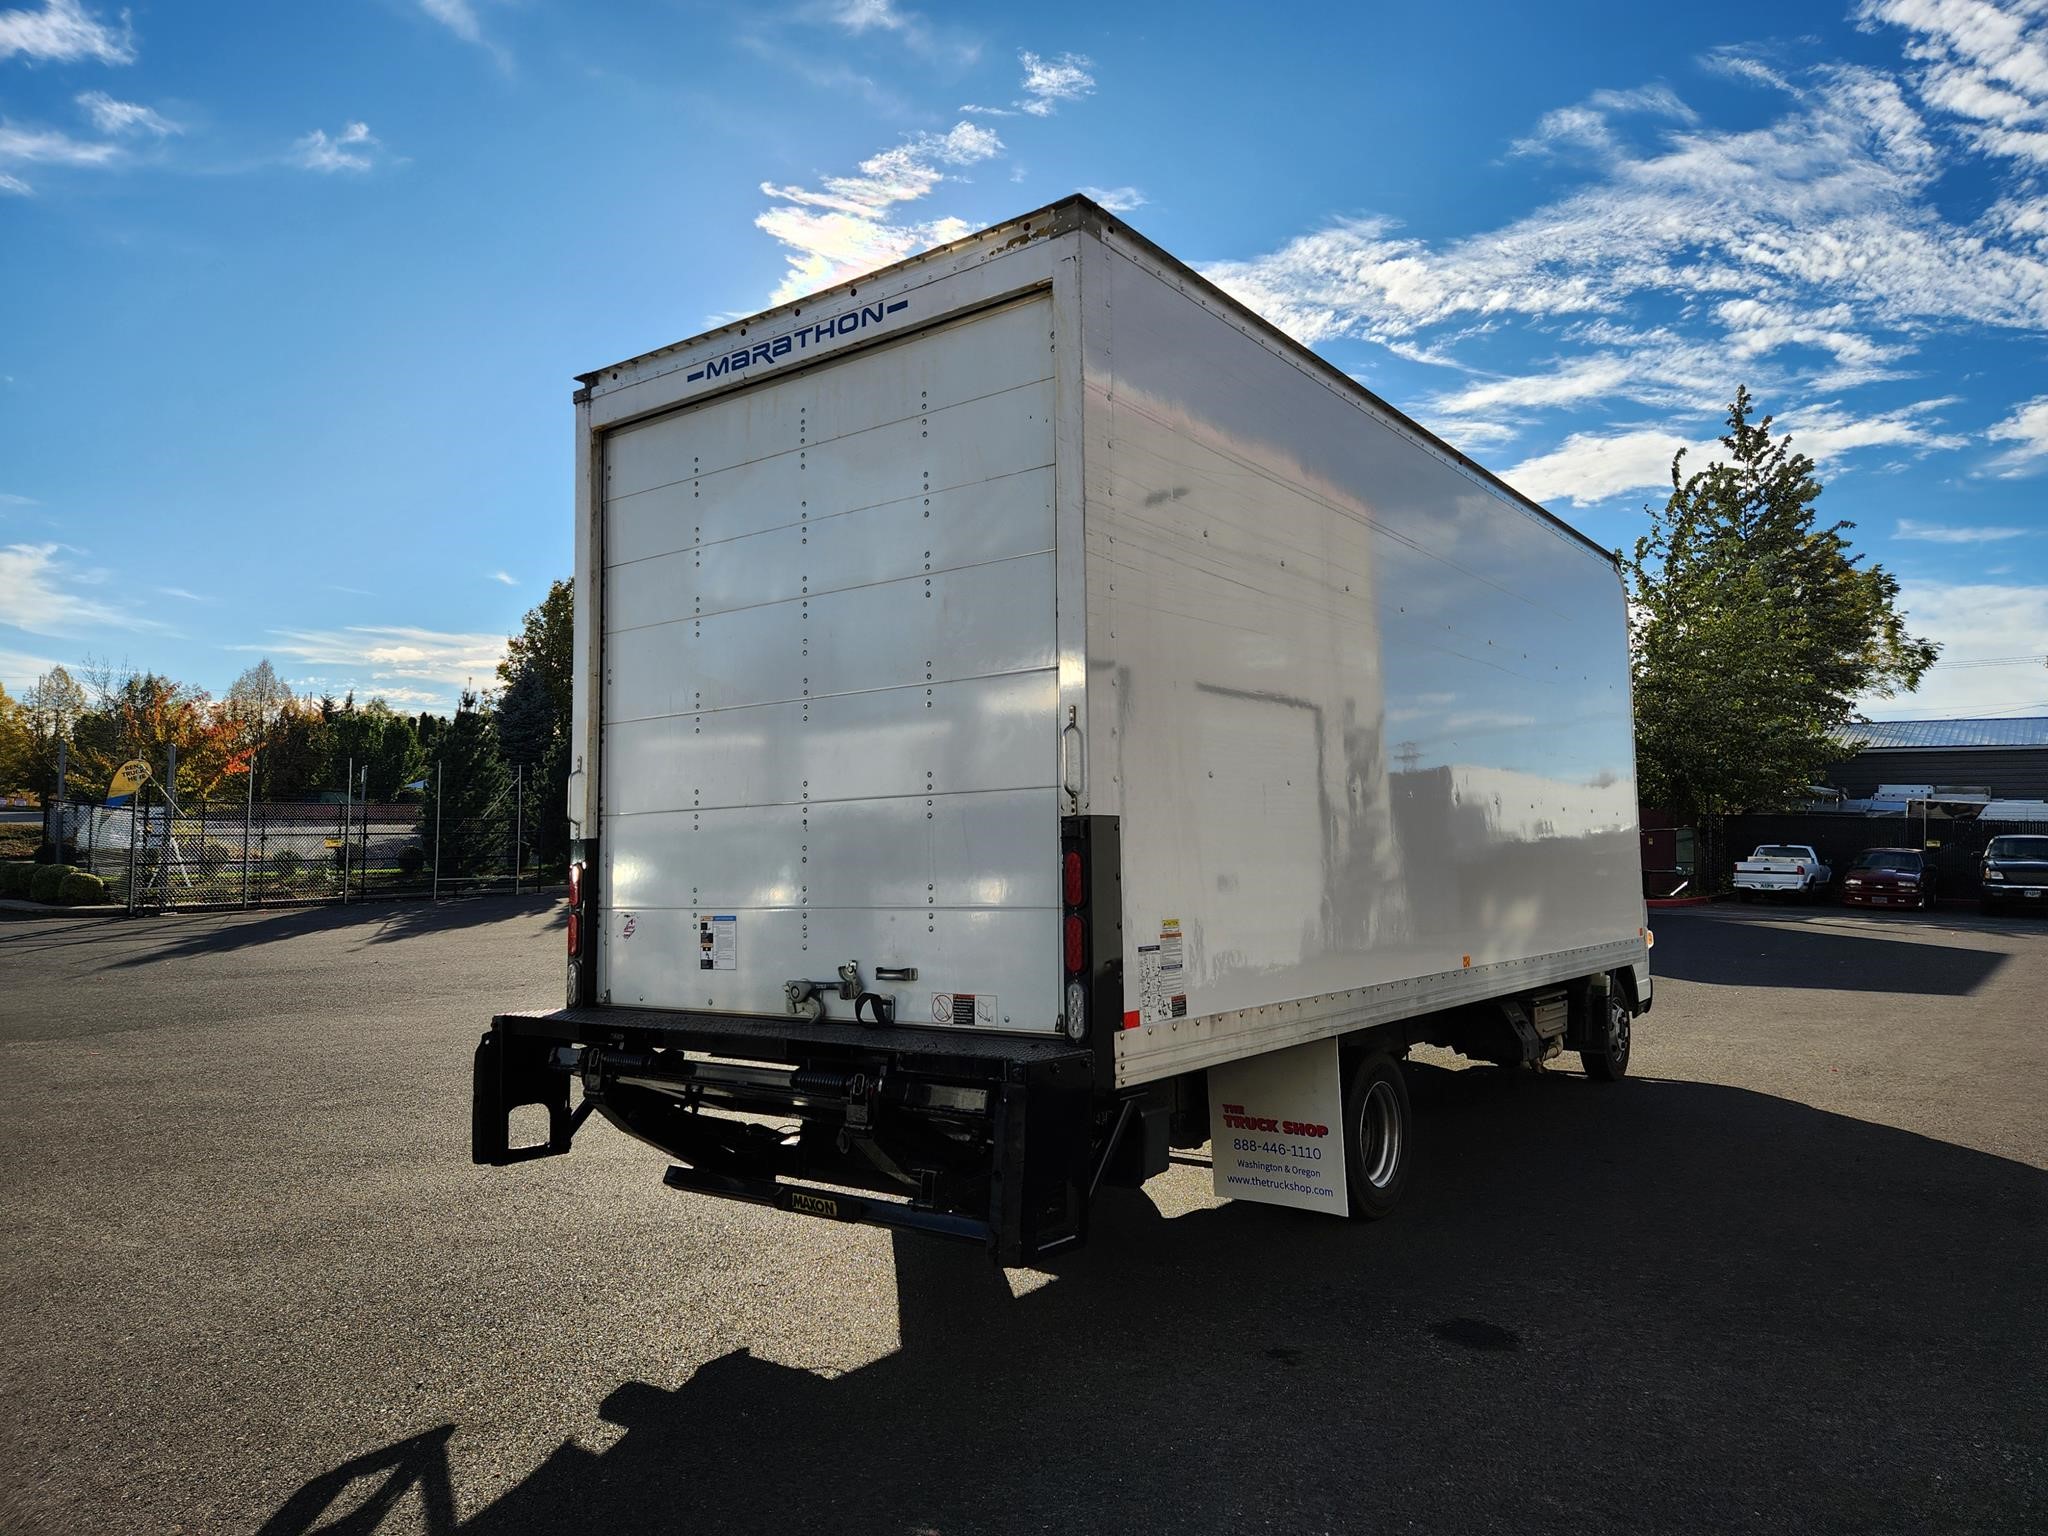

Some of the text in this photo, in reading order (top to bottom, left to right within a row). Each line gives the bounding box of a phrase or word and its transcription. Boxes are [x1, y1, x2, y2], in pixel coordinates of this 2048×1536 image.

[1223, 1114, 1329, 1138] TRUCK SHOP
[1233, 1138, 1322, 1160] 888-446-1110
[1237, 1160, 1321, 1178] Washington & Oregon
[1226, 1175, 1334, 1197] www.thetruckshop.com
[793, 1194, 834, 1215] MAXON
